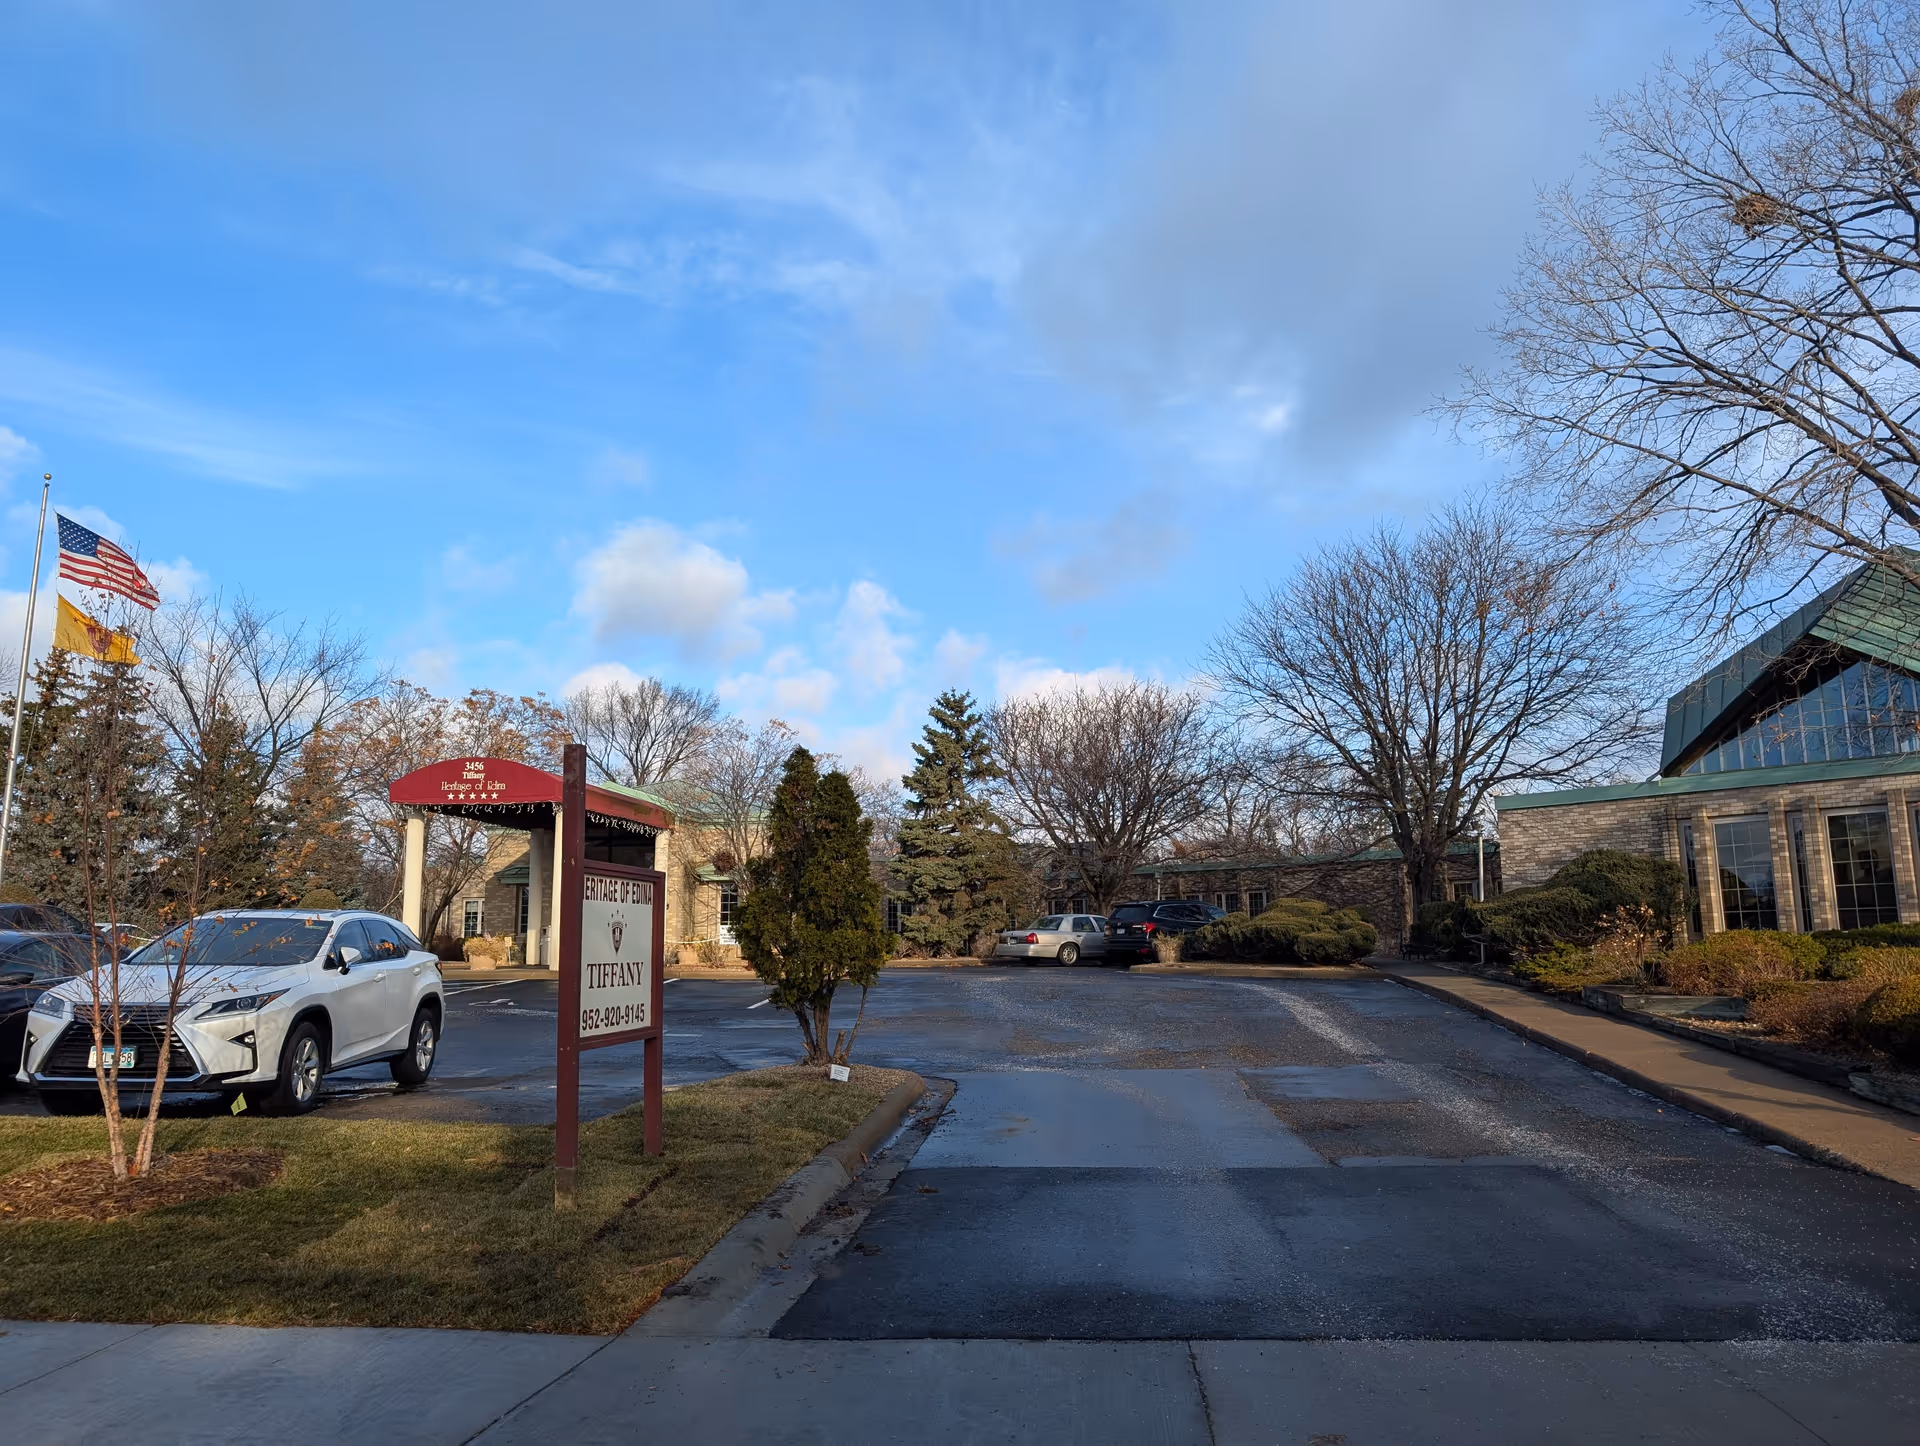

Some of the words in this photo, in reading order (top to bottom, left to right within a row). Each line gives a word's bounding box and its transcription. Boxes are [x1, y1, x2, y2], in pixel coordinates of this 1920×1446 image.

[462, 771, 485, 781] Tiffany
[464, 761, 484, 771] 3456
[441, 780, 472, 792] Heritage
[474, 780, 485, 790] of
[487, 780, 506, 790] Edina
[583, 876, 618, 903] ERITAGE
[620, 880, 629, 904] OF
[631, 882, 652, 906] EDINA
[586, 961, 644, 990] TIFFANY
[582, 1003, 645, 1031] 952-920-9145
